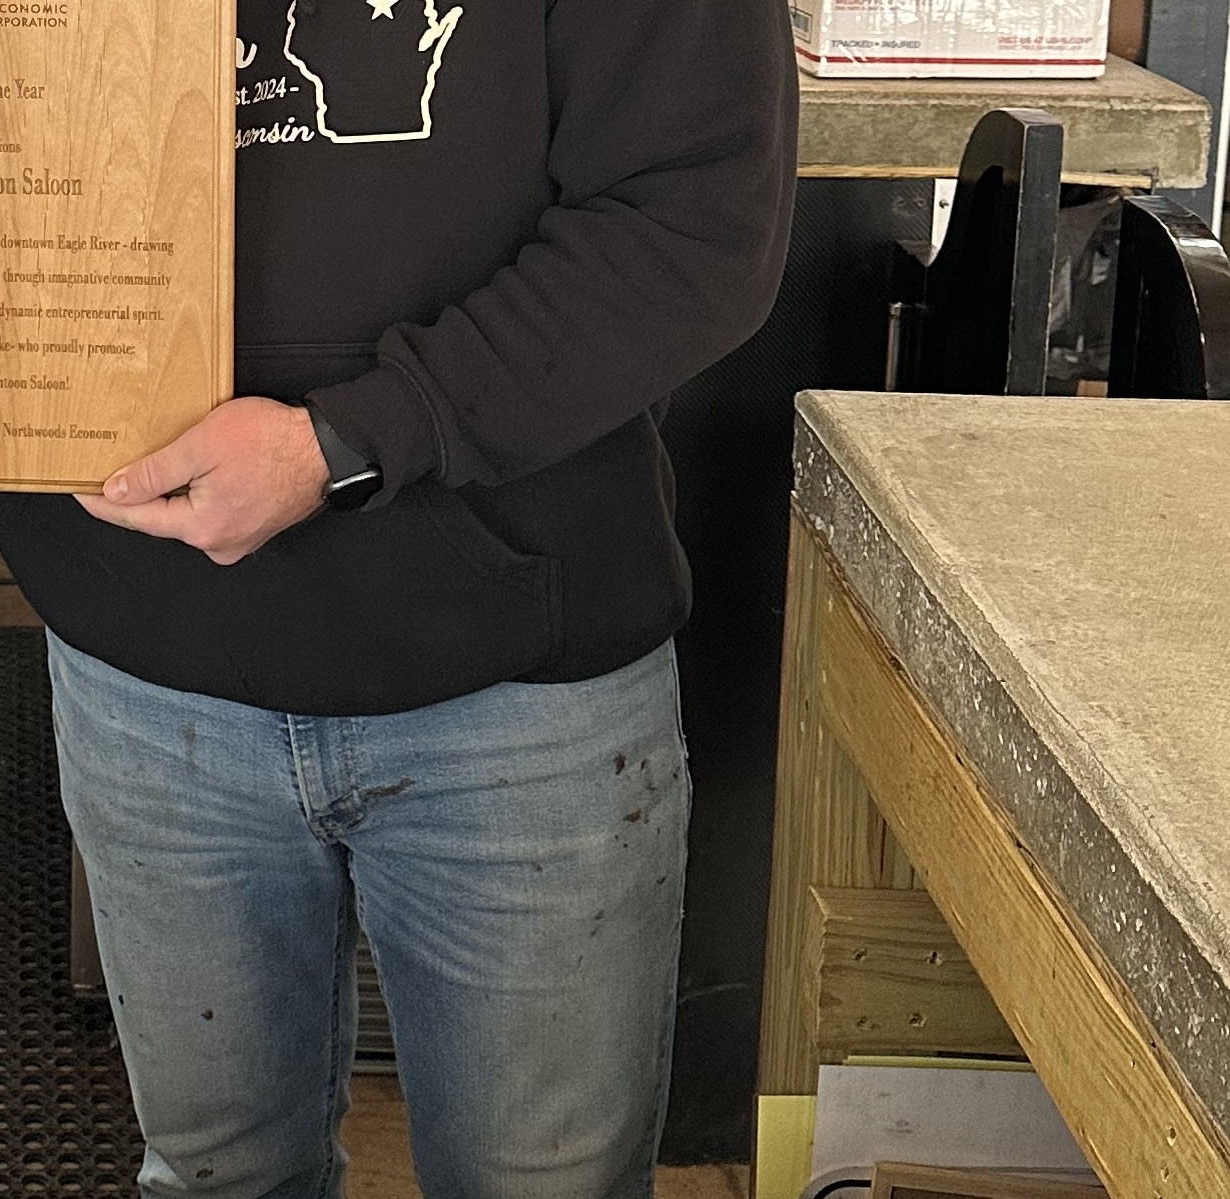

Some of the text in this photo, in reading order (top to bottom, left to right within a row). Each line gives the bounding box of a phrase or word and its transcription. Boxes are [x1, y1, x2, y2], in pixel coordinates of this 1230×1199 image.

[14, 79, 45, 100] Year
[253, 76, 286, 103] 2024
[22, 167, 84, 196] Saloon
[0, 234, 54, 250] downtown
[57, 234, 87, 254] Eagle
[90, 235, 120, 251] River
[130, 236, 174, 256] drawing
[3, 268, 45, 287] through
[48, 268, 109, 287] imaginative
[112, 271, 172, 290] community
[30, 374, 70, 391] Saloon!
